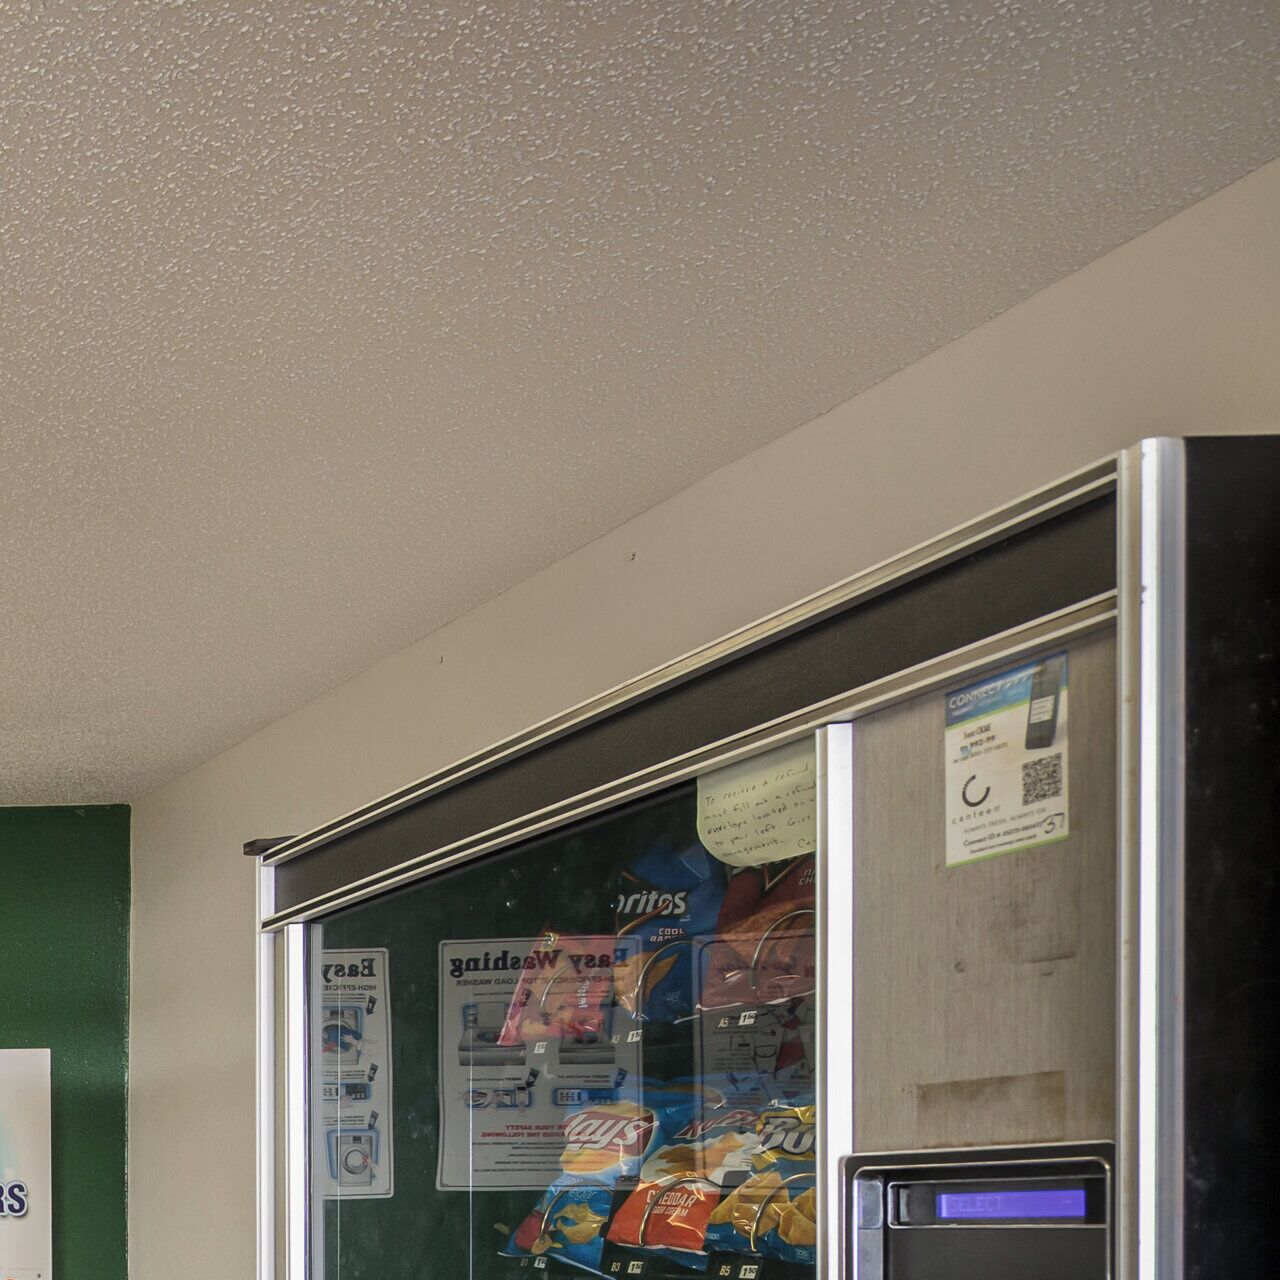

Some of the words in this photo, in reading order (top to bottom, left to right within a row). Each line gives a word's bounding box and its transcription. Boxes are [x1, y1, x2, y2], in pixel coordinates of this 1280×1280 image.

[952, 807, 998, 825] canteen
[659, 927, 684, 935] COOL
[719, 1265, 731, 1276] B5
